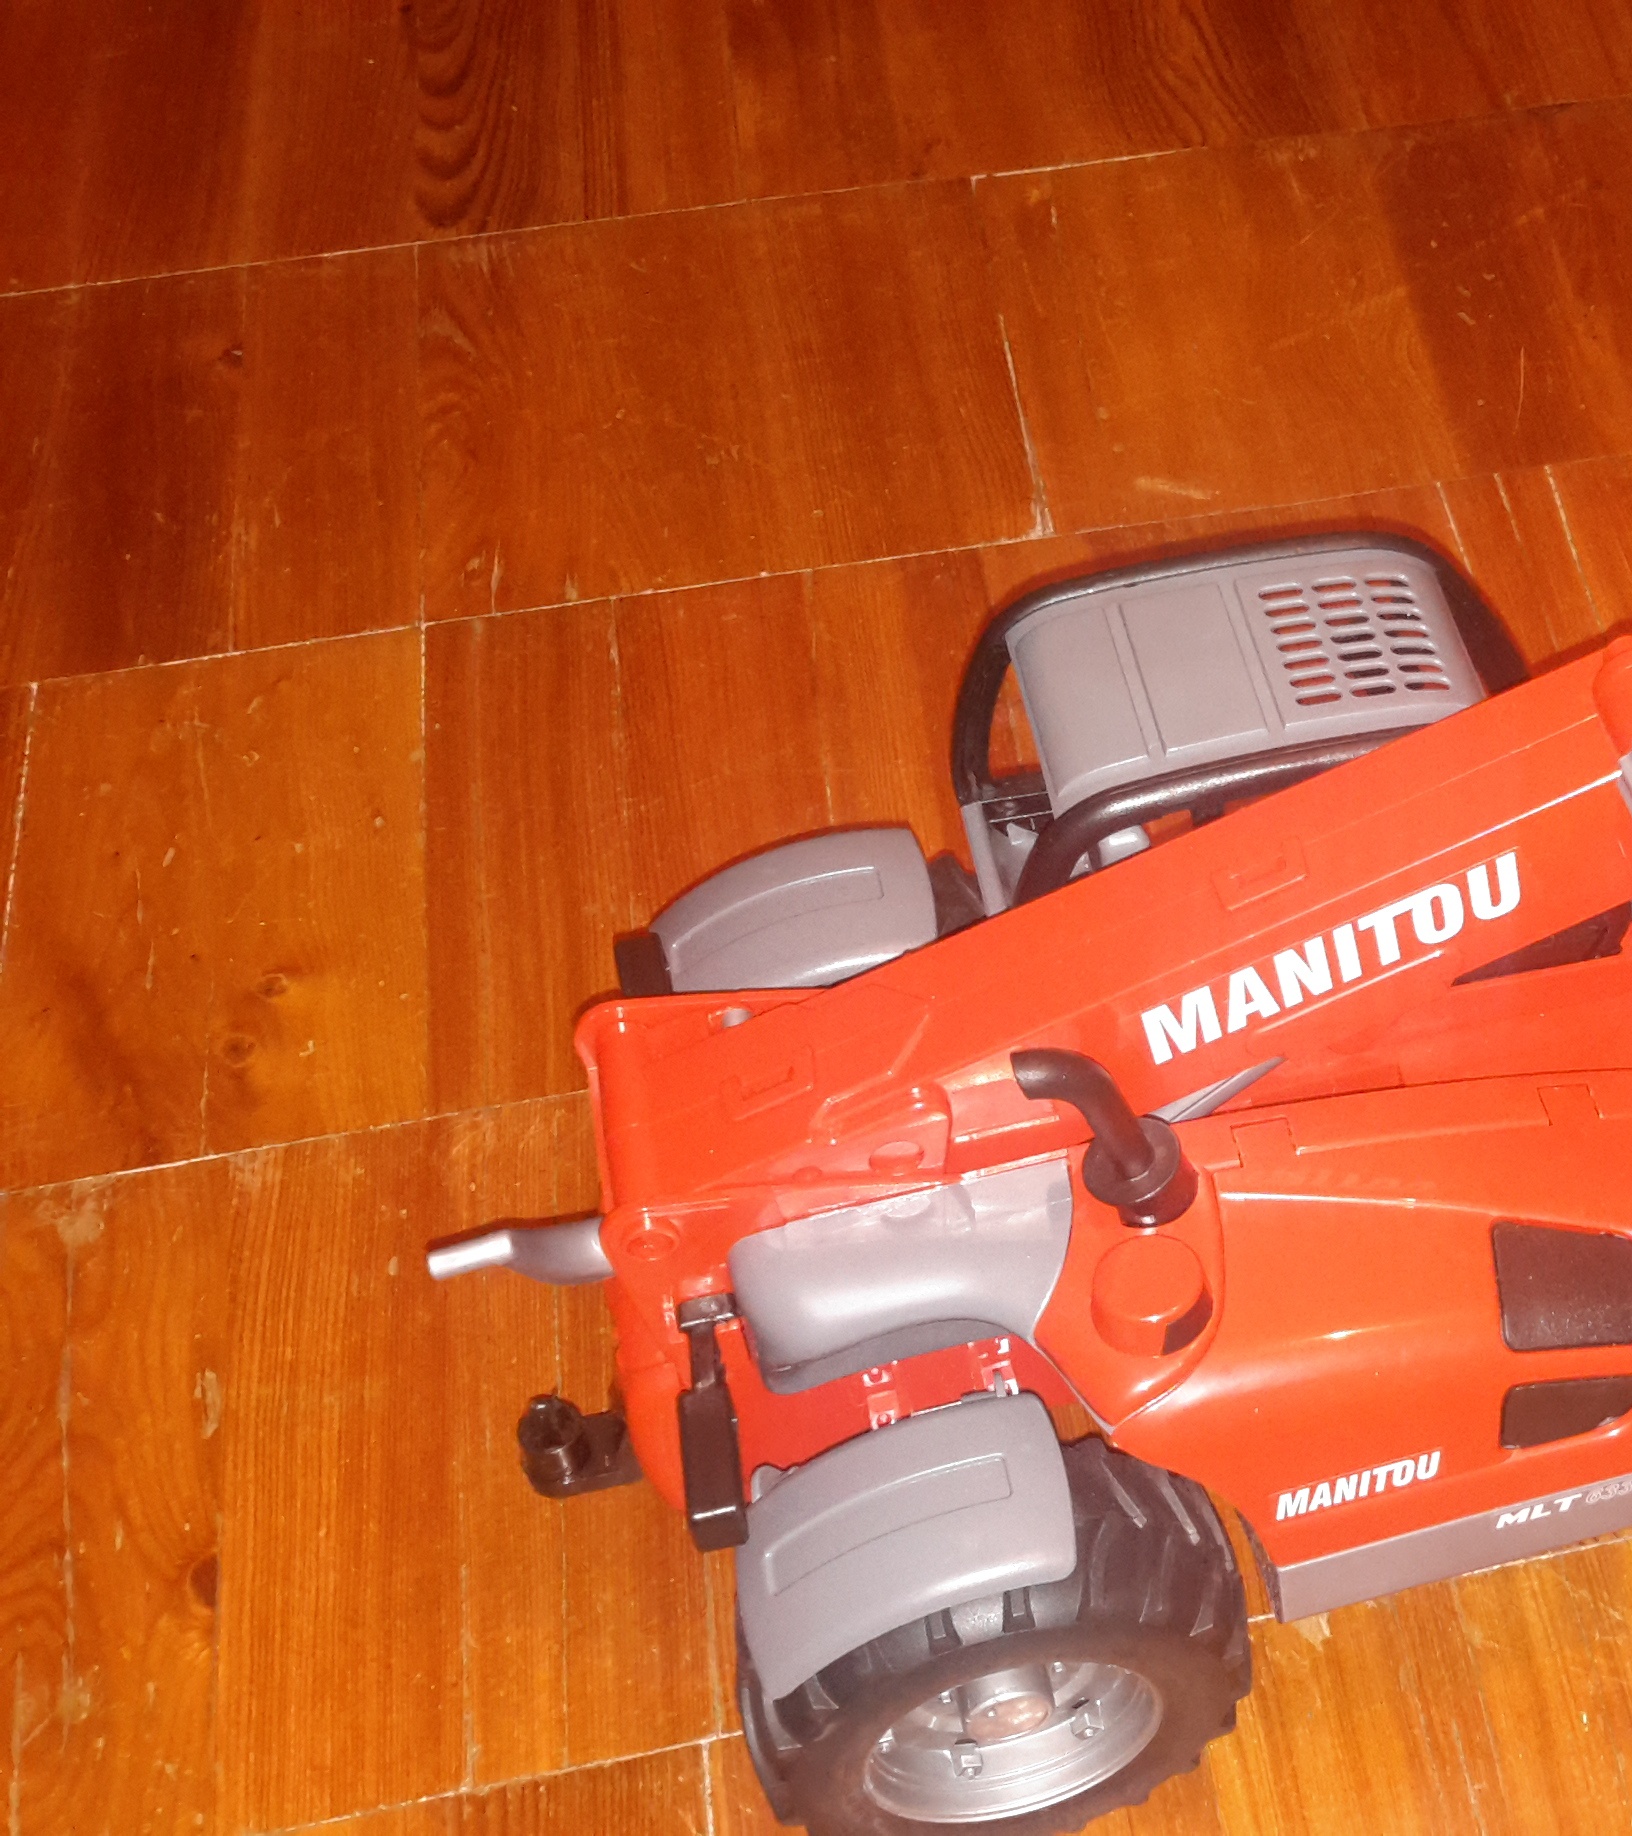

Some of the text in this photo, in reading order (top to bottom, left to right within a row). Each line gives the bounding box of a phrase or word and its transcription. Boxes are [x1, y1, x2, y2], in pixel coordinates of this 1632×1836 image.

[1140, 851, 1521, 1066] MANITOU
[1275, 1450, 1441, 1522] MANITOU
[1495, 1493, 1583, 1529] MLT
